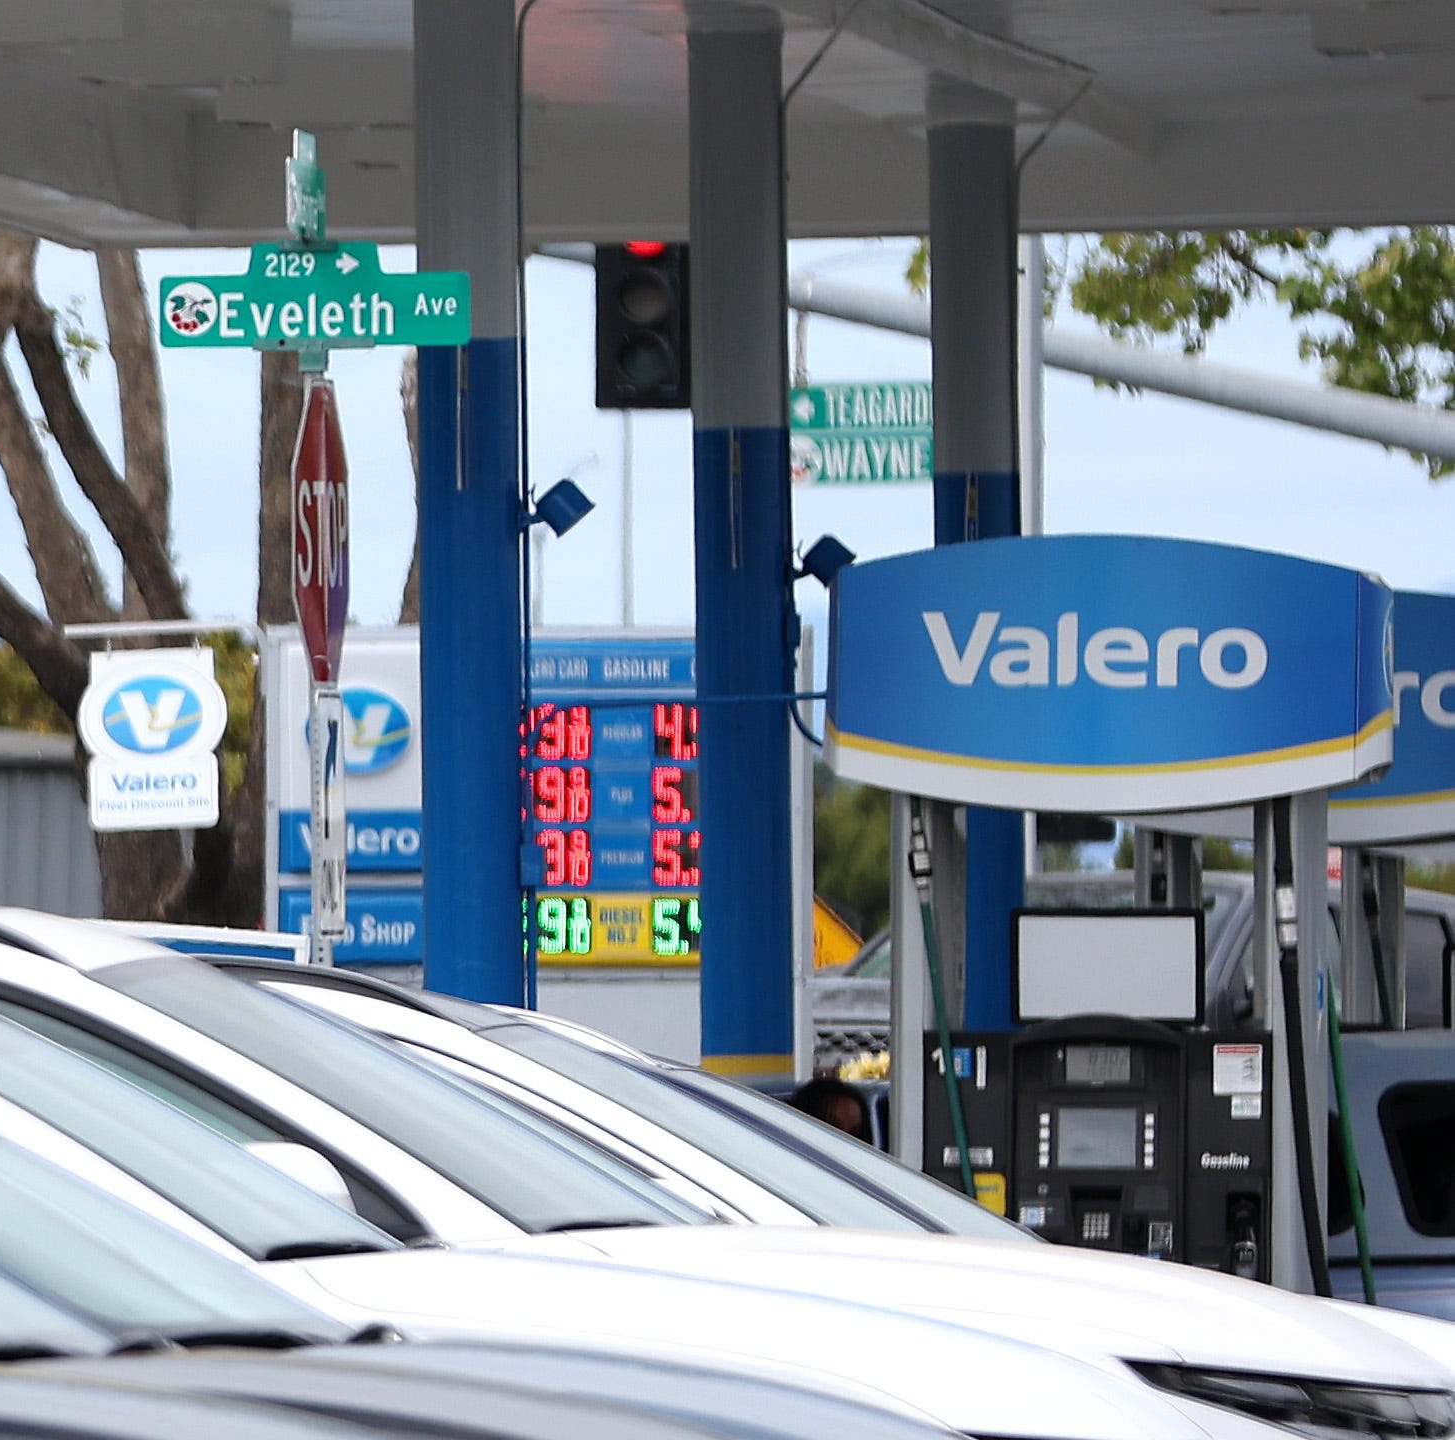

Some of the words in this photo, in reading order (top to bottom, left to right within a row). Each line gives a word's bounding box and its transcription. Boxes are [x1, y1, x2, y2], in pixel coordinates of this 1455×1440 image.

[265, 253, 316, 277] 2129
[219, 291, 395, 338] Eveleth
[414, 293, 458, 317] Ave
[825, 386, 932, 425] TEAGARD
[822, 437, 931, 478] WAYNE
[298, 480, 348, 588] STOP
[922, 611, 1269, 690] Valero
[603, 659, 670, 681] GASOLINE
[111, 771, 199, 794] Valero
[300, 822, 421, 856] Vlero
[1201, 1152, 1250, 1170] Gasoline
